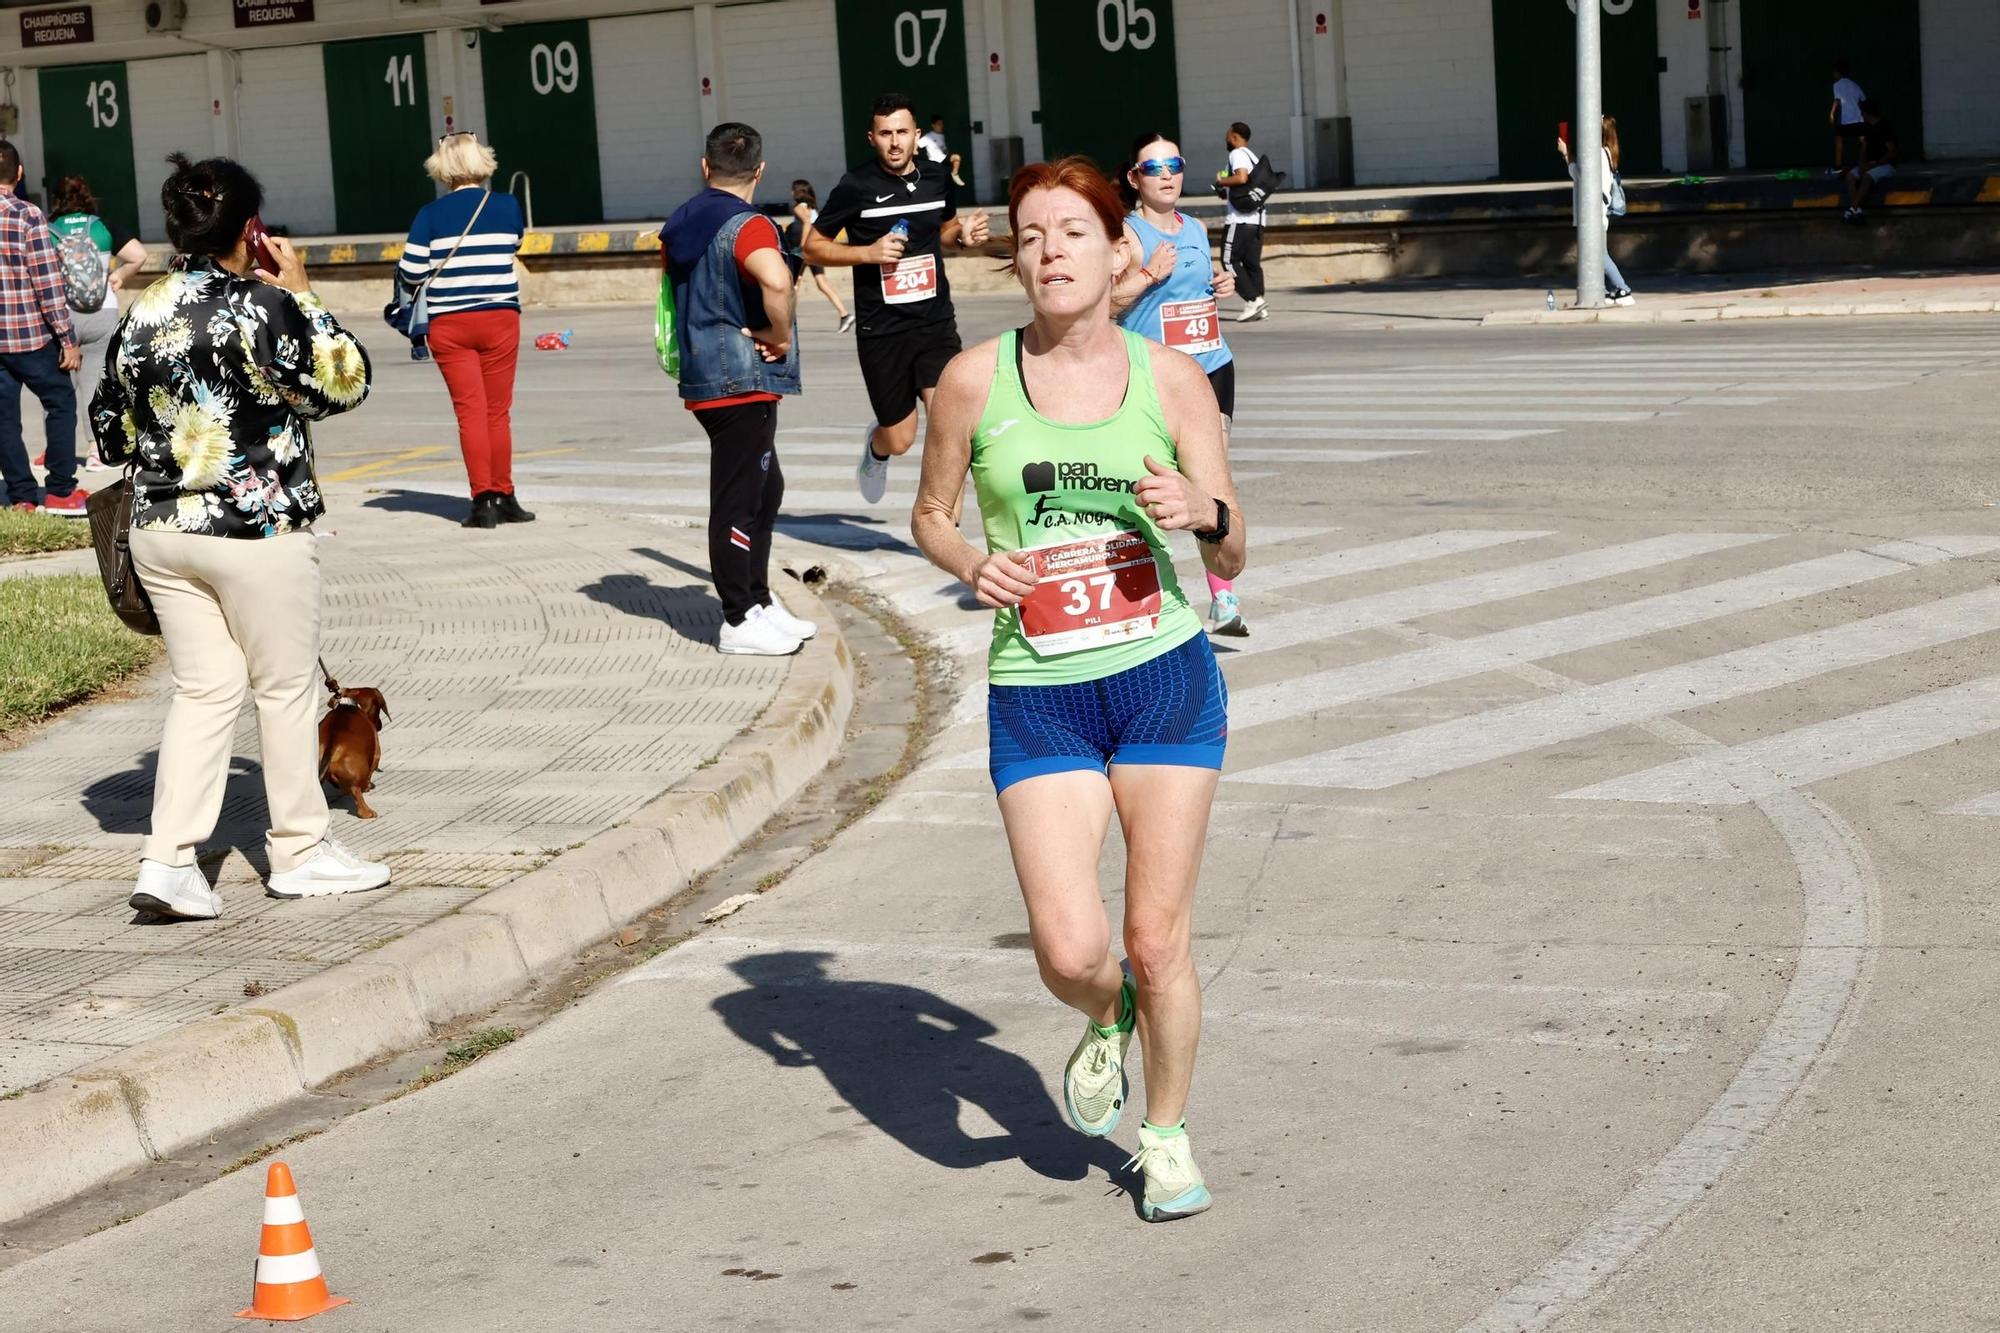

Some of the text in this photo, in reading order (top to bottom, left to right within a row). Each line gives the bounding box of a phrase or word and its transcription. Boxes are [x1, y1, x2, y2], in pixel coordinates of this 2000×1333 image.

[23, 12, 86, 29] CHAMPIÑONES
[249, 6, 295, 22] REQUENA
[34, 27, 77, 43] REQUENA
[1098, 0, 1155, 52] 05
[895, 9, 947, 67] 07
[530, 41, 579, 95] 09
[384, 54, 415, 107] 11
[86, 80, 119, 128] 13
[895, 270, 929, 290] 204
[1184, 318, 1209, 337] 49
[1058, 462, 1098, 481] pan
[1051, 547, 1097, 561] CARRERA
[1098, 537, 1147, 554] SOLIDARIA
[1047, 551, 1118, 570] MERCAMURCIA
[1060, 573, 1115, 616] 37
[1085, 616, 1102, 625] PILI
